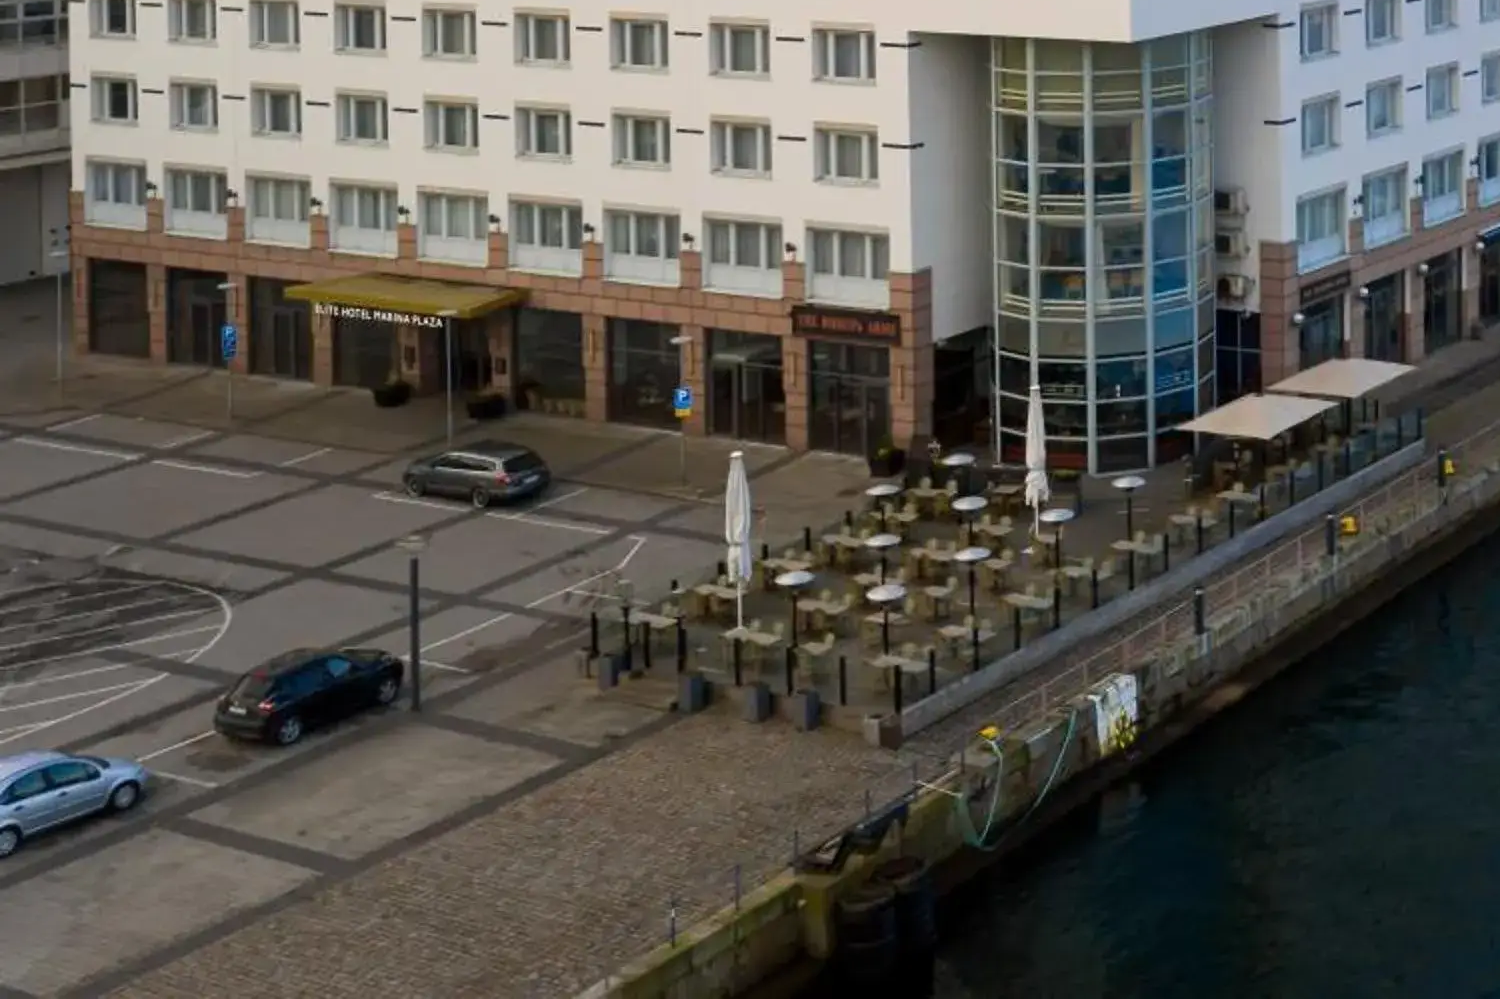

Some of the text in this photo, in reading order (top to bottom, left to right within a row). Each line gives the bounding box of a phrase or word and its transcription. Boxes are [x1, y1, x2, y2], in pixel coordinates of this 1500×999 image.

[315, 303, 339, 317] ELITE
[341, 306, 371, 320] HOTEL
[412, 314, 443, 328] PLAZA
